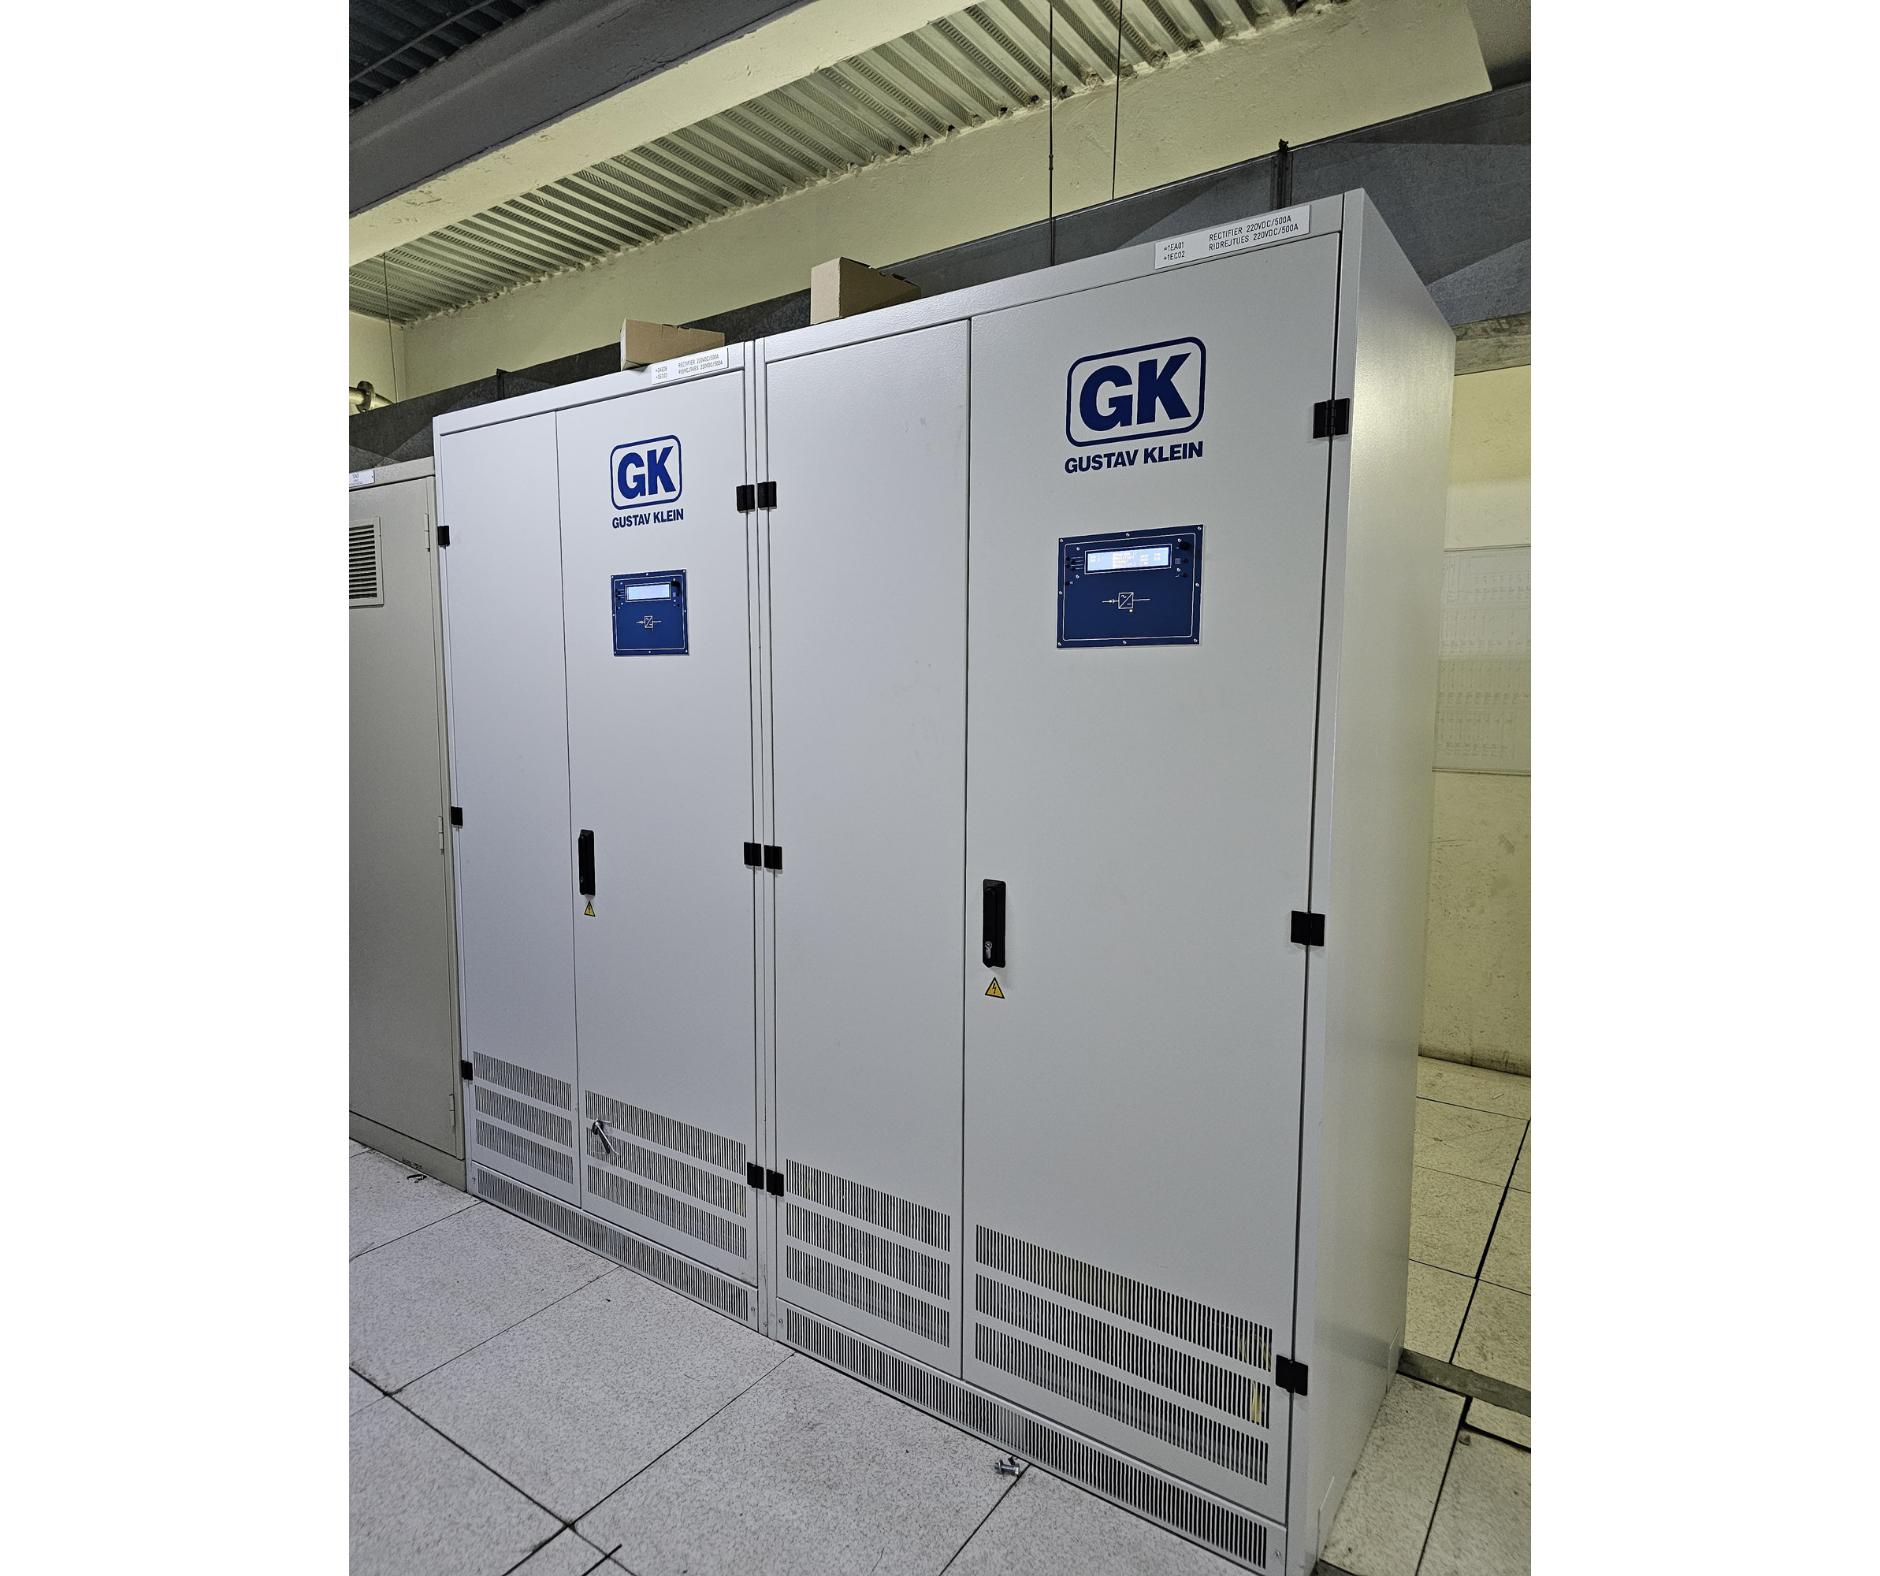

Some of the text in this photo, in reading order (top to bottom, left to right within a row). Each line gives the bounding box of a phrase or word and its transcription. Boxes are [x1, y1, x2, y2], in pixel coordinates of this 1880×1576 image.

[1208, 215, 1292, 242] RECTIFIER 220VDC/500A
[1208, 223, 1299, 251] RIDREJTUES 220VDC/500A
[1079, 352, 1192, 432] GK
[617, 445, 676, 499] GK
[1064, 441, 1203, 474] GUSTAV KLEIN
[612, 508, 684, 529] GUSTAV KLEIN
